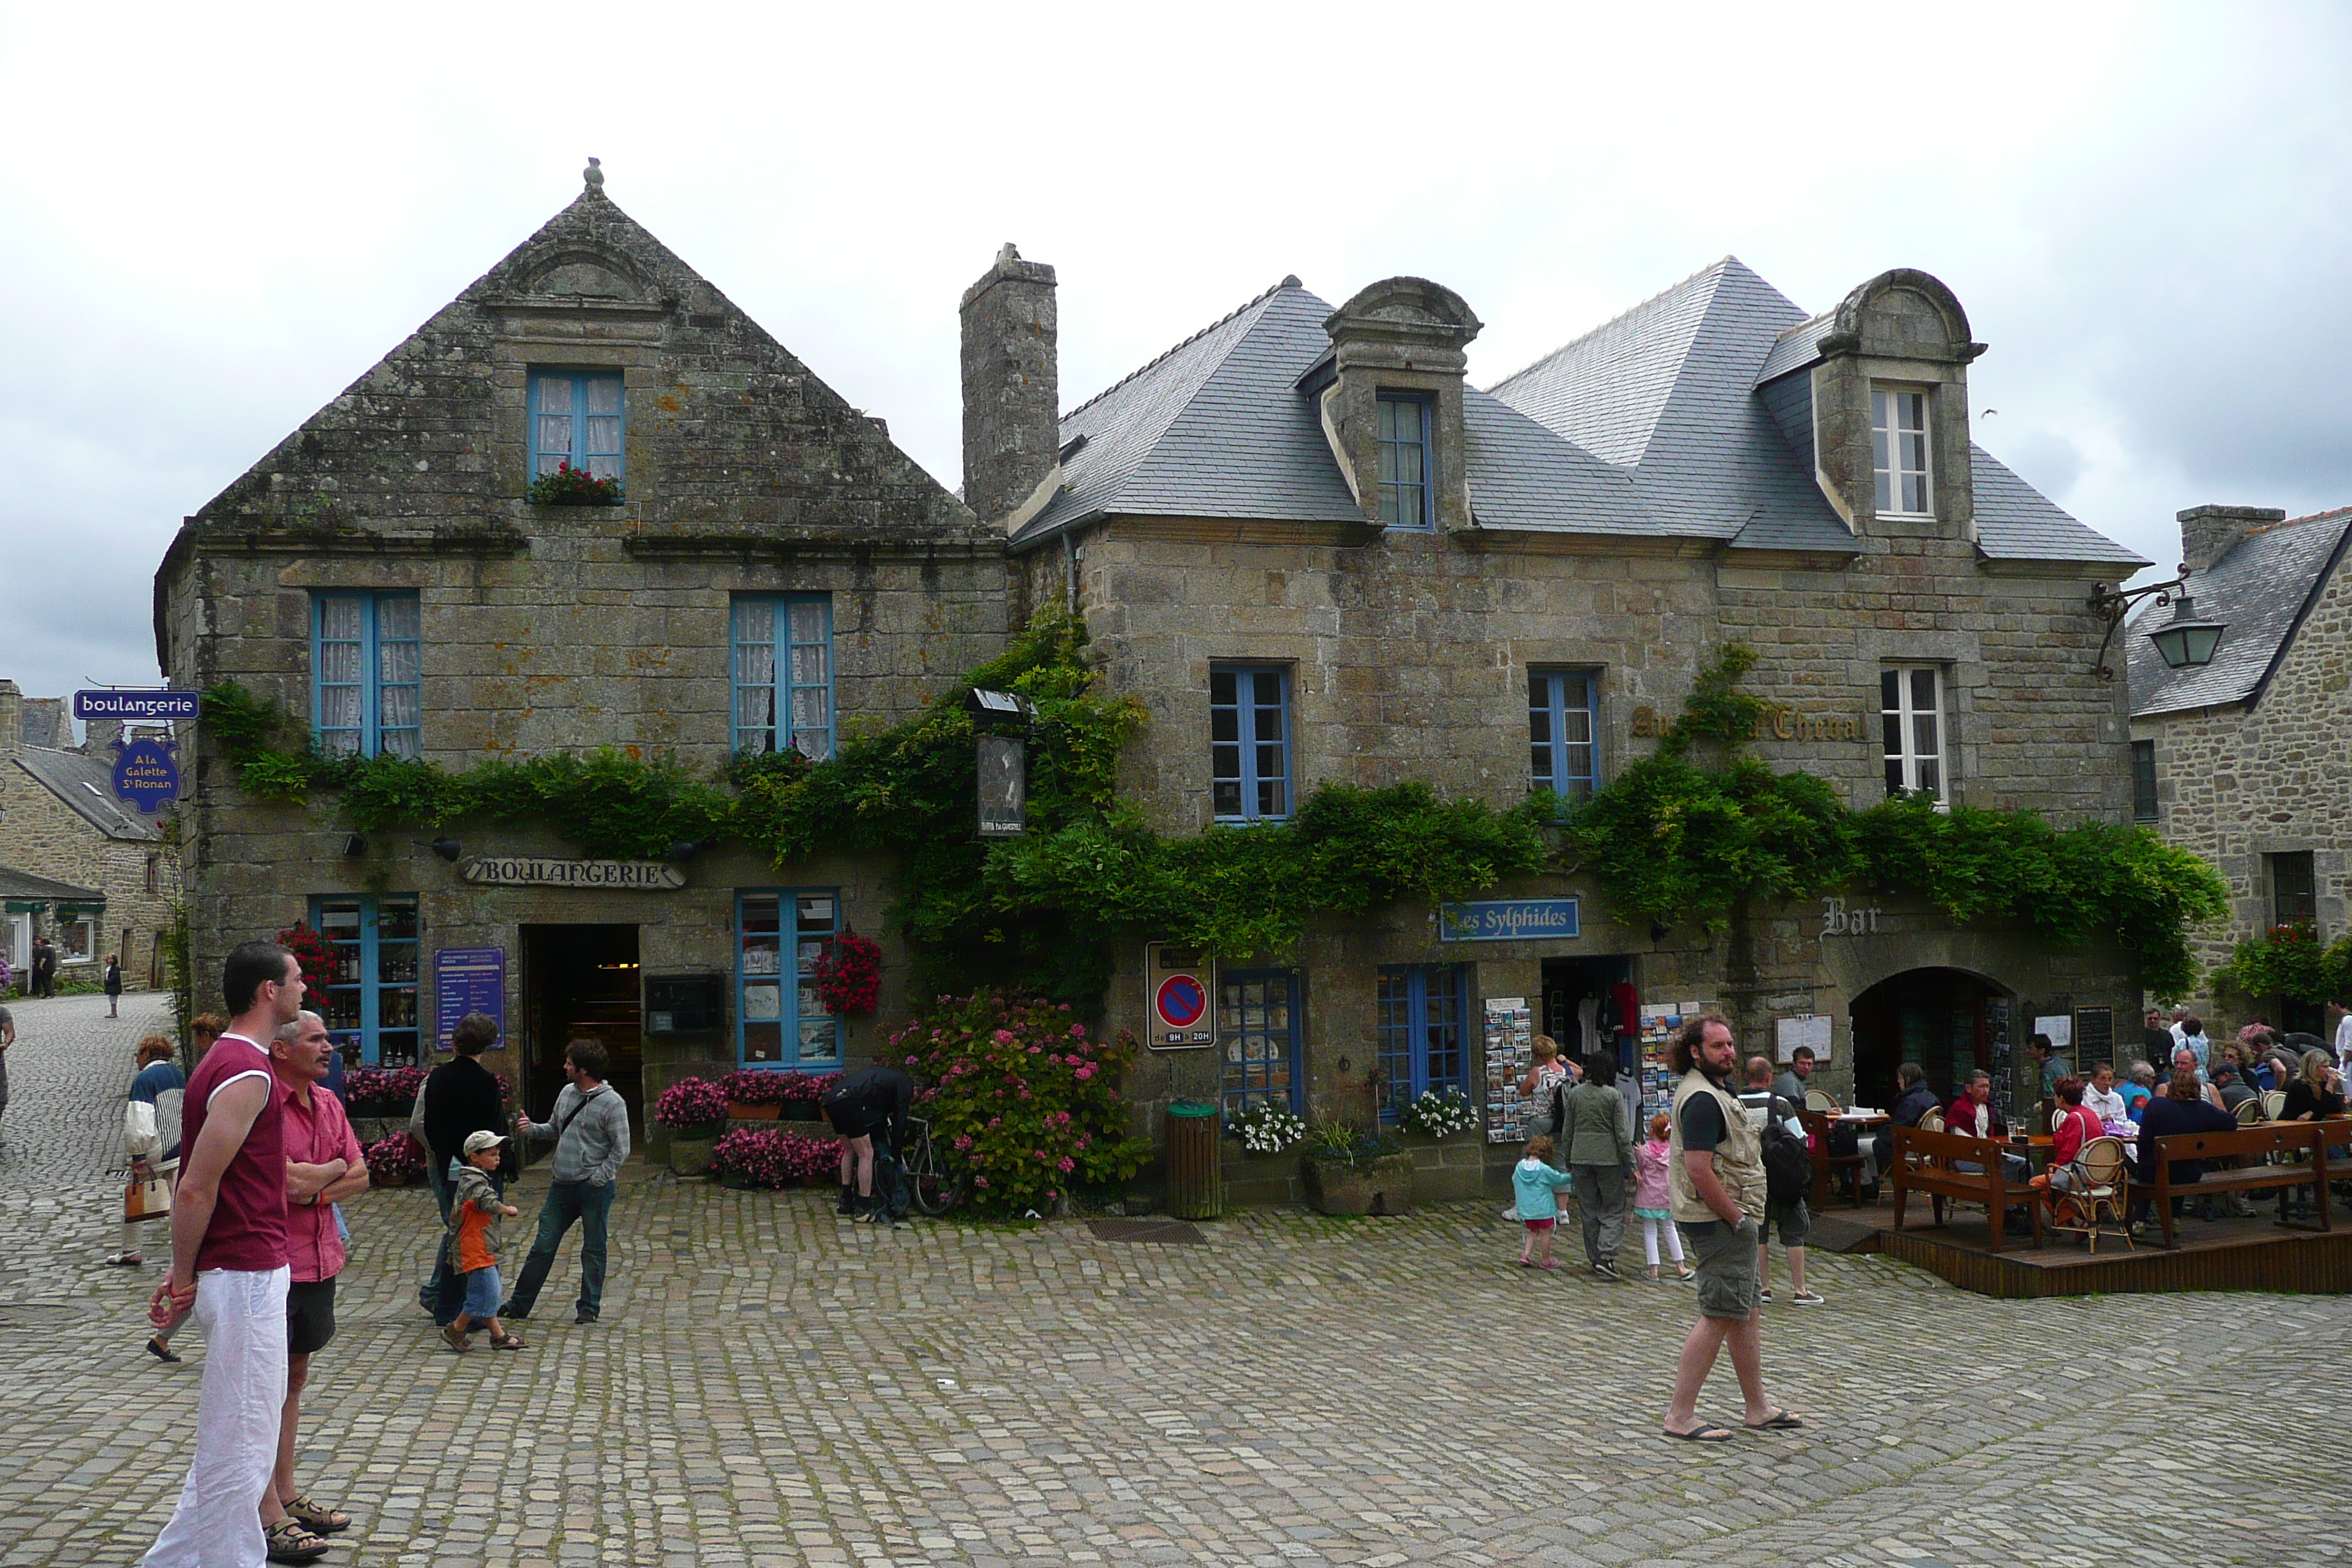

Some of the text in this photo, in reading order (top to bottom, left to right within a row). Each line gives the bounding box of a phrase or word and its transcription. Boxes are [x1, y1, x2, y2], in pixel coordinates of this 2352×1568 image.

[83, 696, 193, 715] boulangerie
[1774, 710, 1866, 745] Cheval
[135, 755, 157, 765] A la
[126, 767, 167, 777] Galette
[135, 780, 171, 788] Ronan
[484, 861, 660, 883] BOULANGERIE
[1485, 905, 1567, 935] Sylphides
[1819, 897, 1882, 942] Bar
[1155, 1033, 1164, 1041] de
[1169, 1033, 1180, 1041] 9H
[1193, 1032, 1209, 1040] 20H
